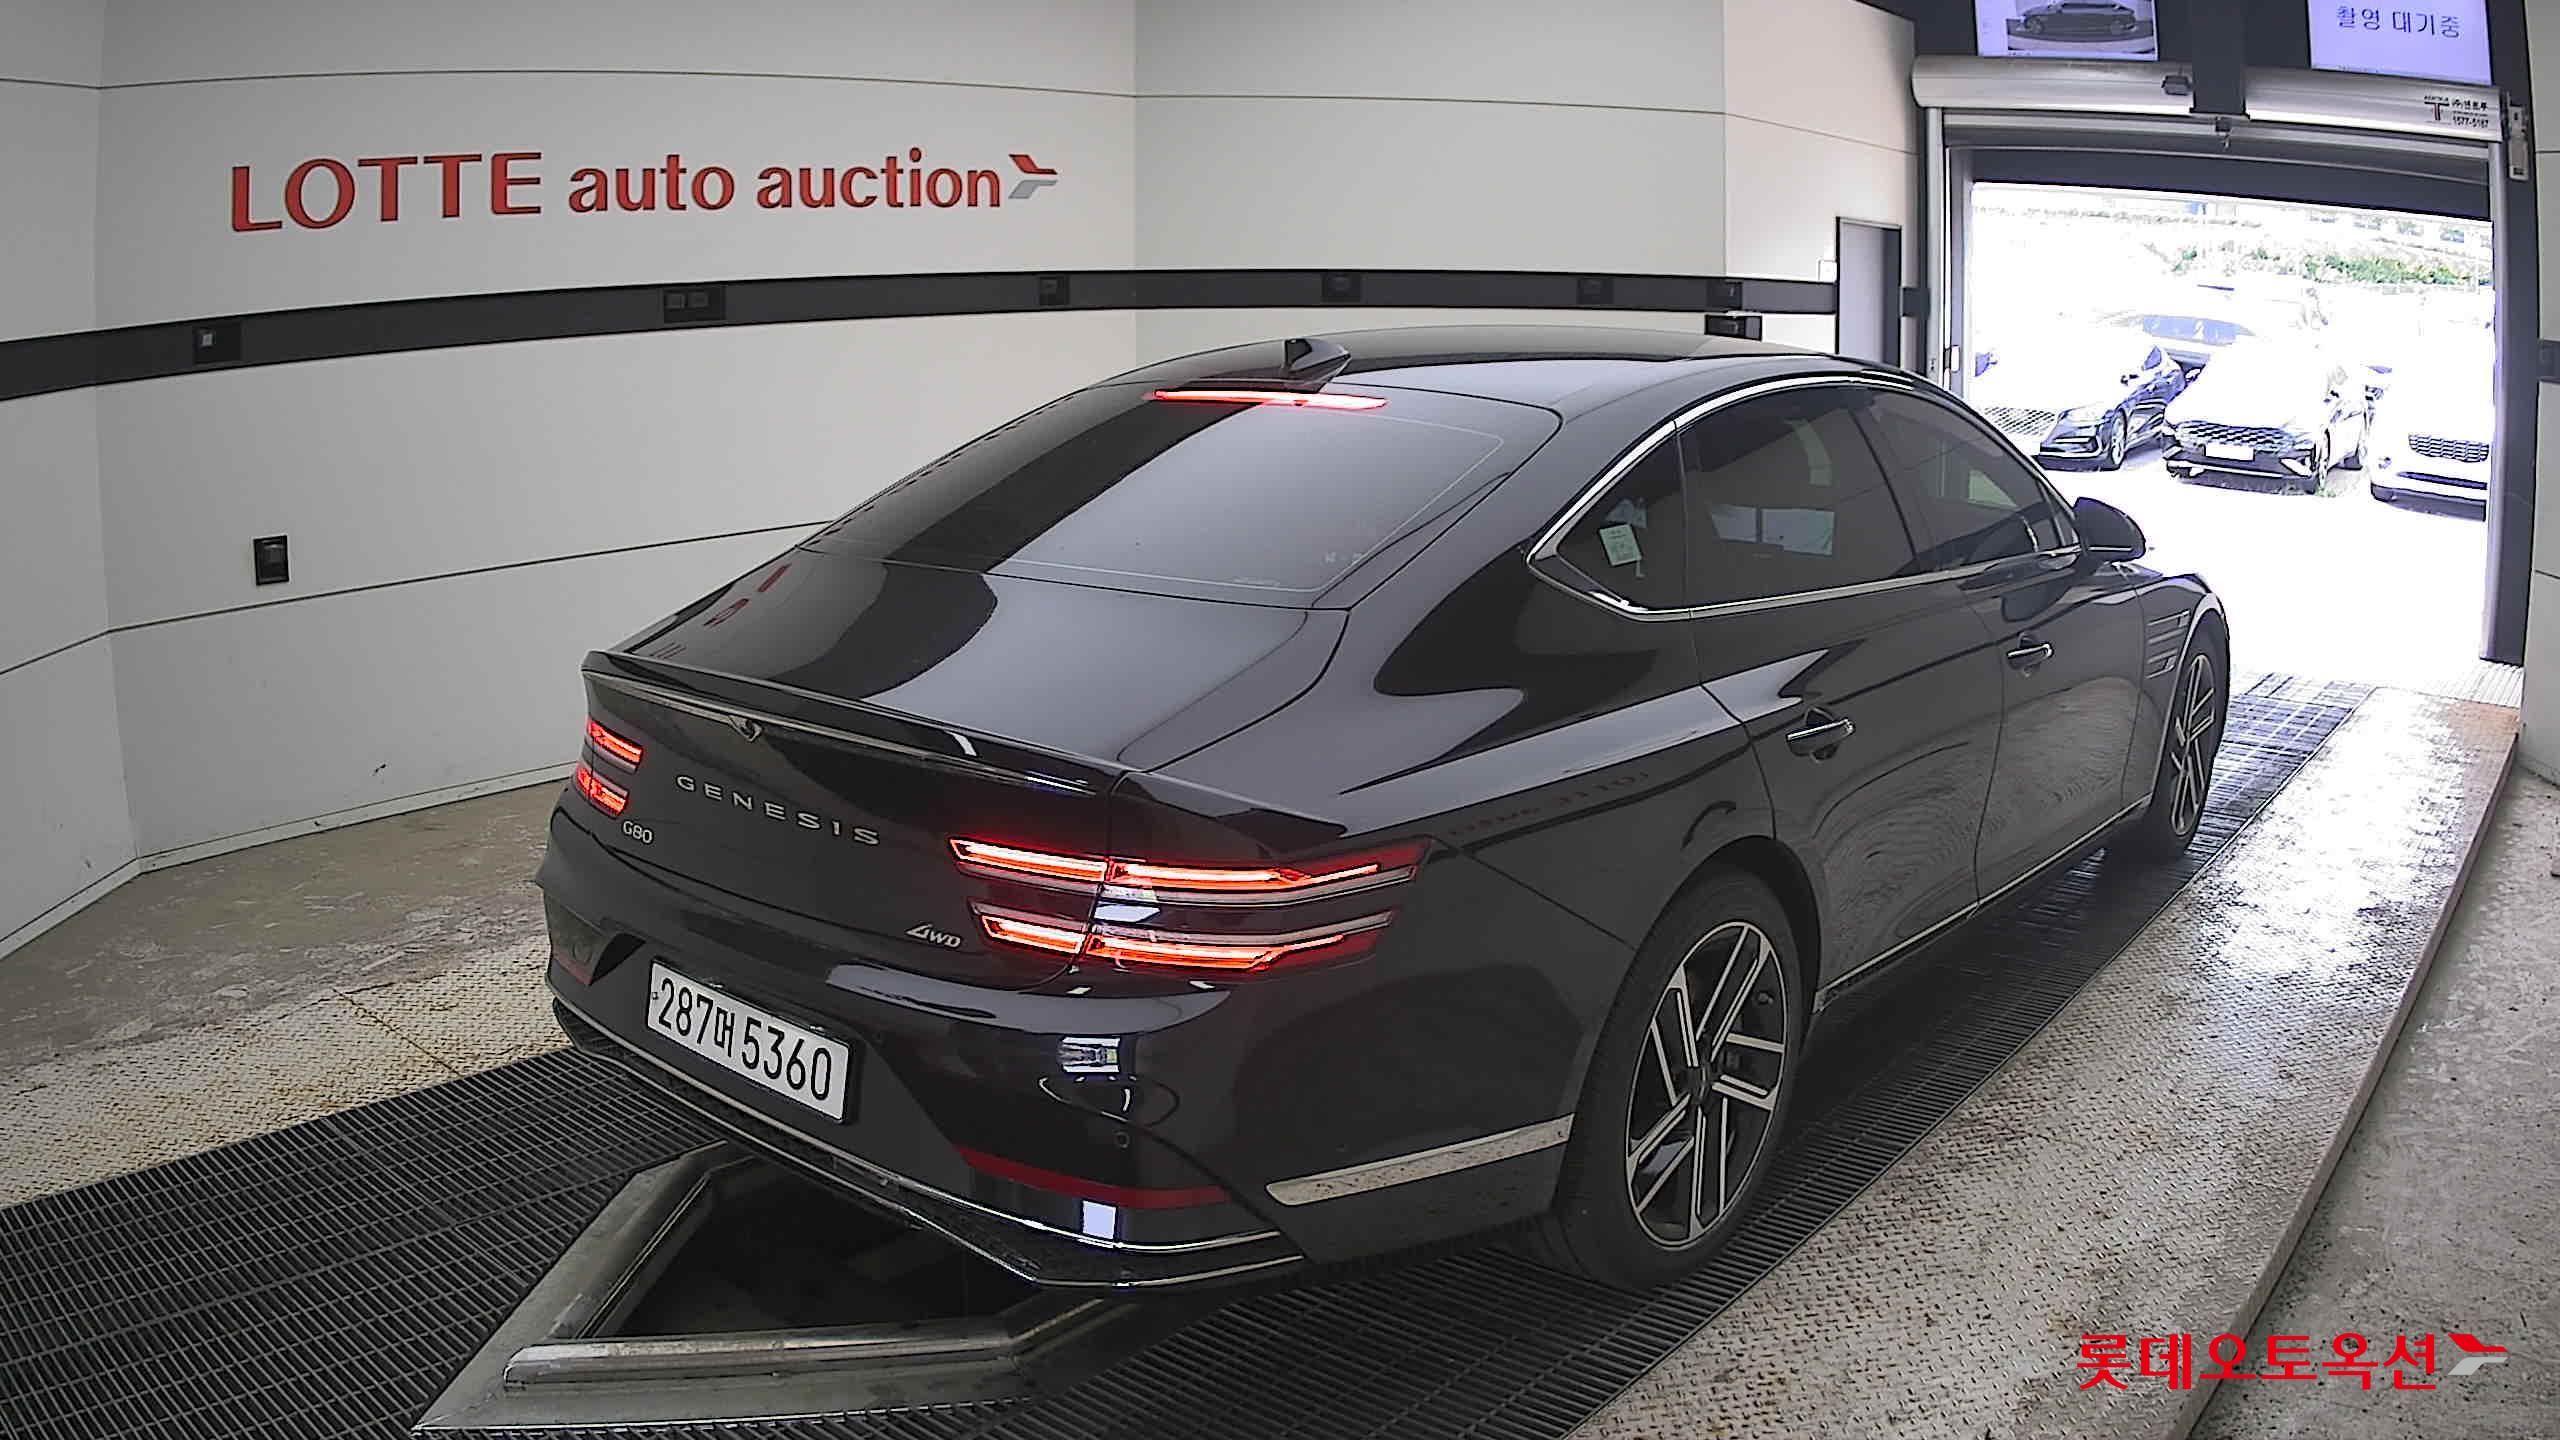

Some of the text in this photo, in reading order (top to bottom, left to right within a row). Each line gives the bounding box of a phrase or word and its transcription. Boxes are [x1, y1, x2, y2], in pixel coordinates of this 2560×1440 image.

[2337, 6, 2381, 31] 촬영
[231, 147, 1002, 233] LOTTE auto auction
[676, 775, 880, 846] GENESIS
[622, 820, 653, 844] G80
[905, 923, 961, 948] 4WD
